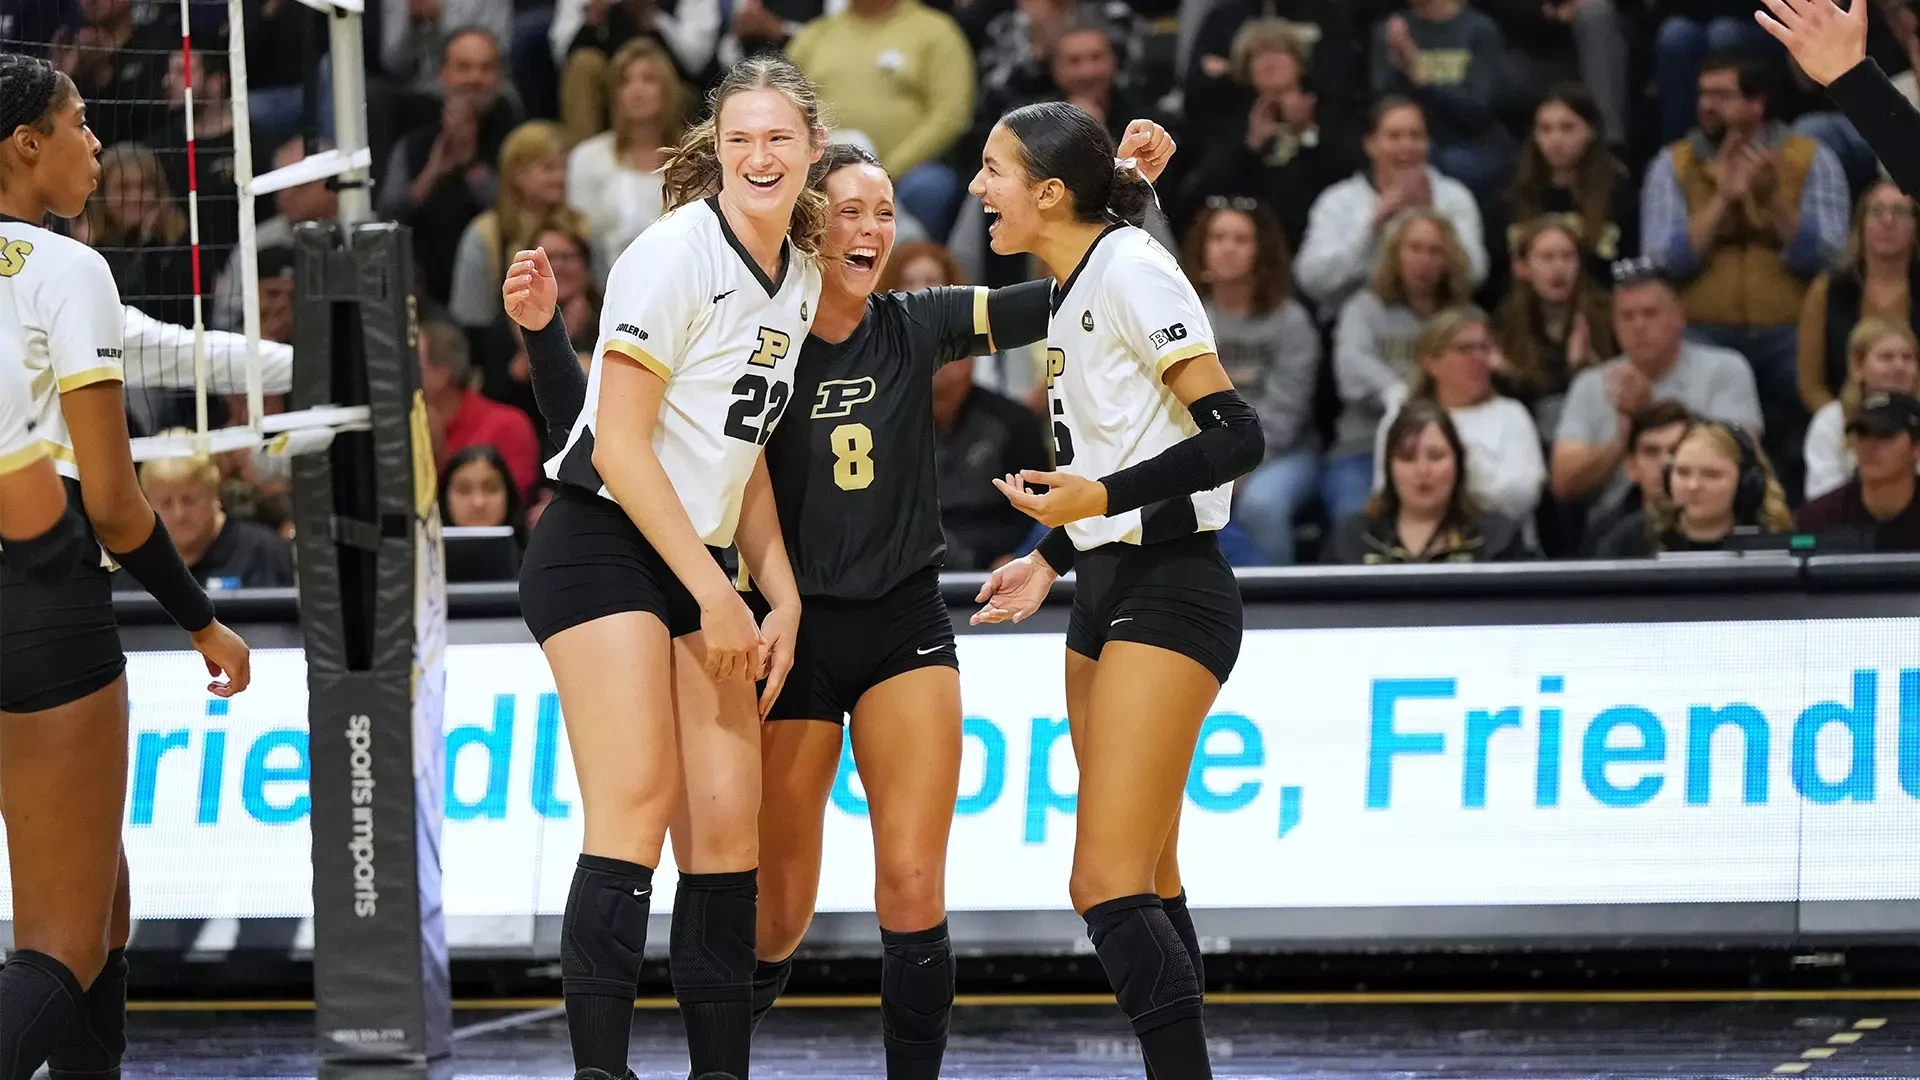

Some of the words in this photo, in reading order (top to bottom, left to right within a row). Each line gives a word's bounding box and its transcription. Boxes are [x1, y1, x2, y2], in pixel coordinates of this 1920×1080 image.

[0, 236, 34, 277] S
[639, 329, 649, 341] UP
[747, 326, 790, 368] P
[723, 373, 789, 446] 22
[810, 376, 877, 419] P
[830, 423, 875, 491] 8
[345, 715, 377, 805] sports
[348, 807, 379, 918] imports
